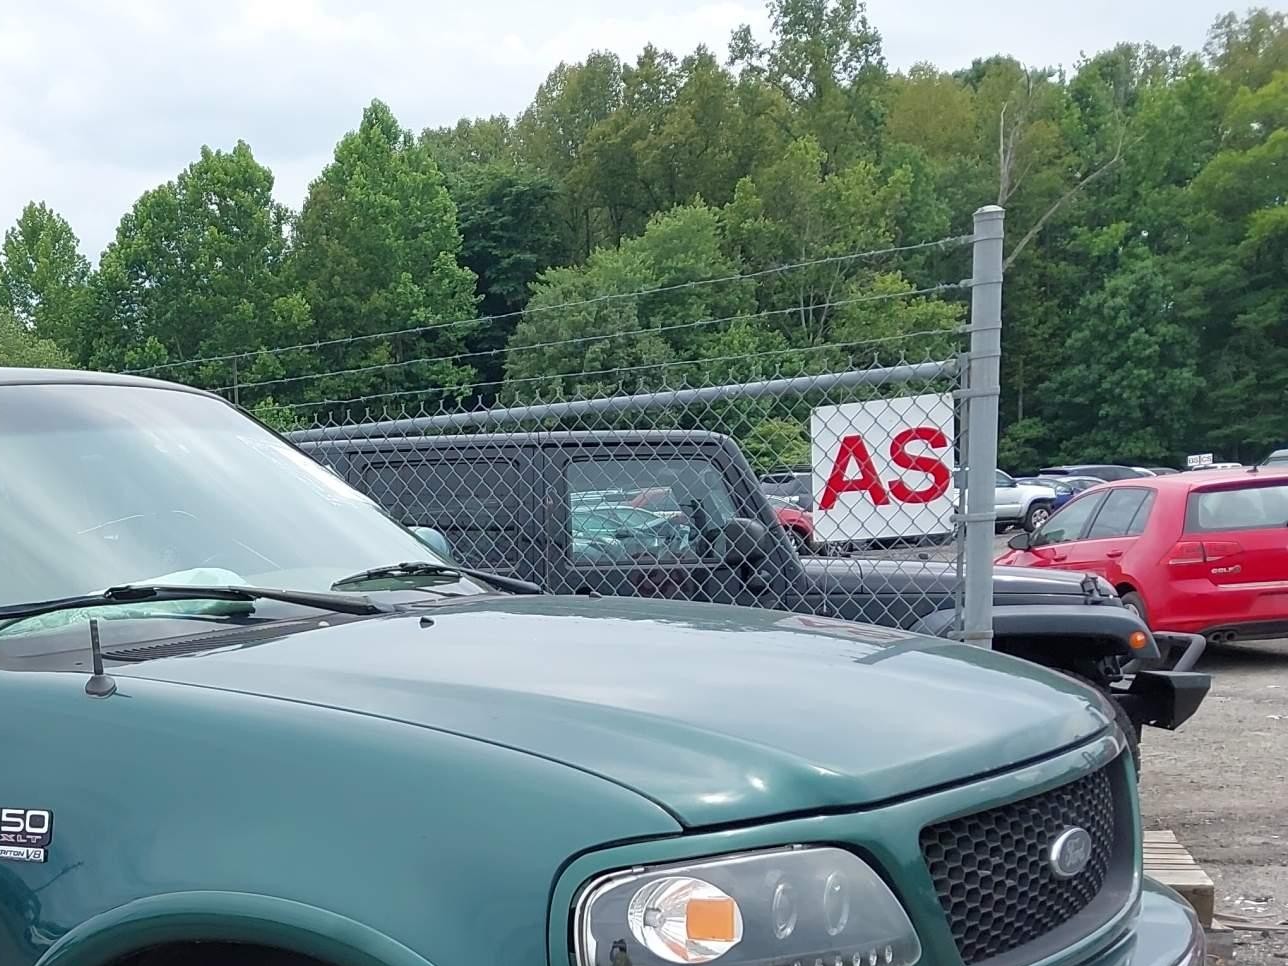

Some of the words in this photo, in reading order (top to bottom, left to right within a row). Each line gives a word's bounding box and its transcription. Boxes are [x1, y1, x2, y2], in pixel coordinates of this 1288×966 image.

[819, 427, 950, 510] AS
[0, 834, 42, 843] XLT
[26, 849, 42, 859] V8
